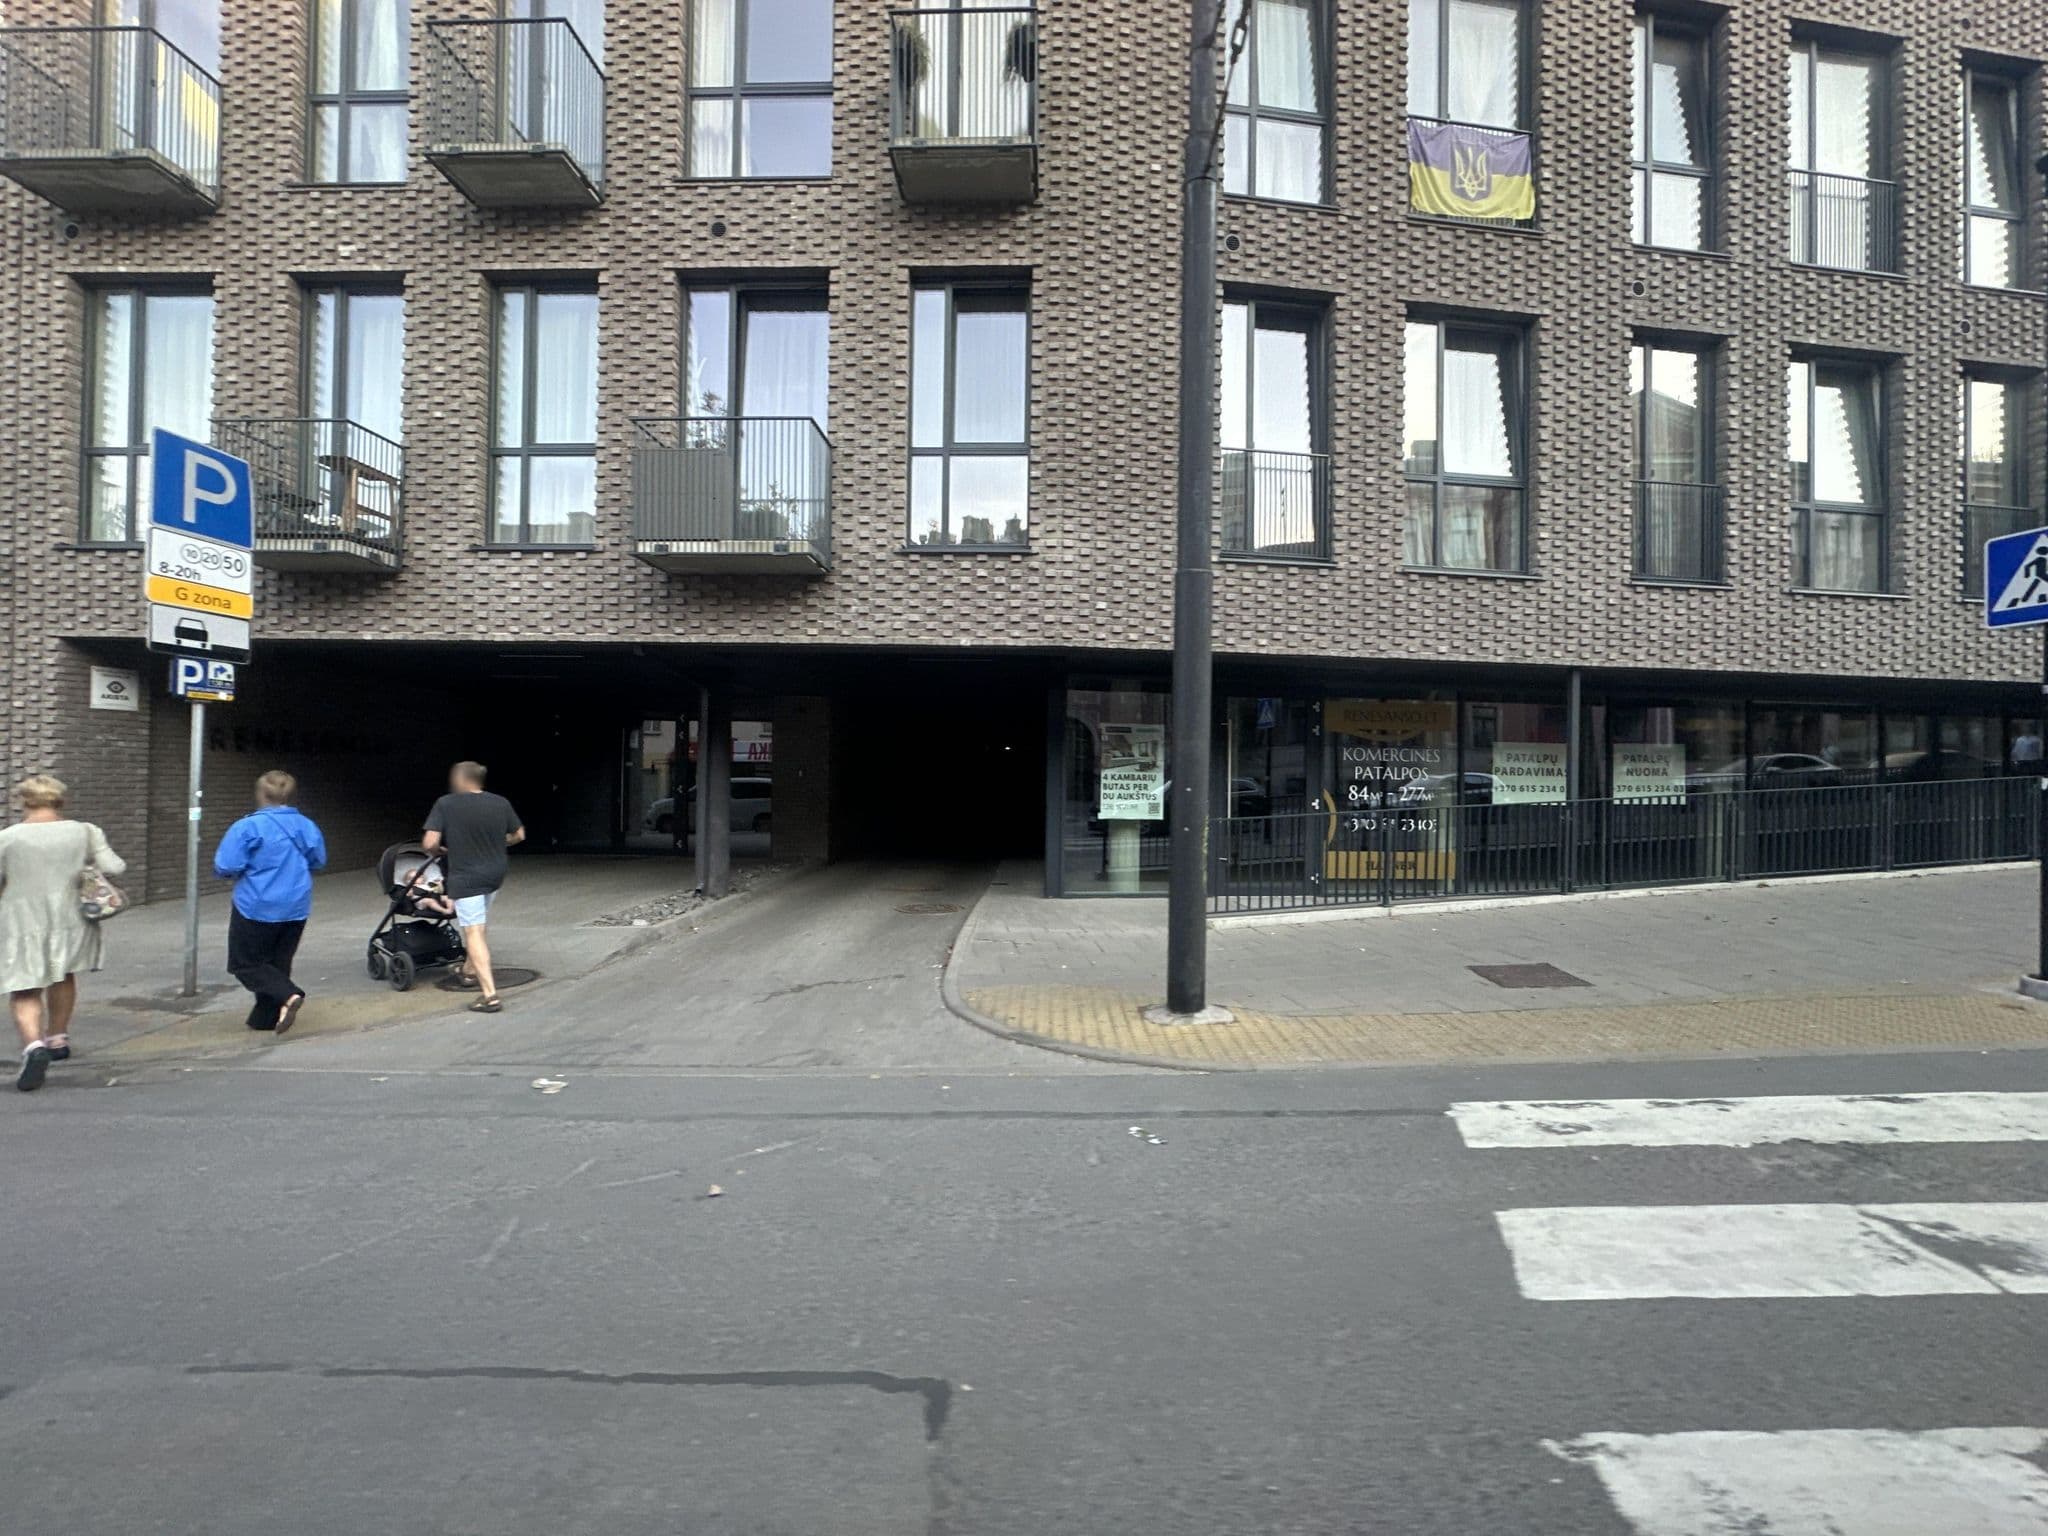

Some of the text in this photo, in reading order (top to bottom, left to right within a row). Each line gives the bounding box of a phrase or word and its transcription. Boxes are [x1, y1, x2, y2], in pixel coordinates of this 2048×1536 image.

[182, 448, 238, 524] P
[185, 548, 243, 572] 10 20 50
[159, 561, 201, 581] 8-20h
[175, 587, 232, 609] G zona
[177, 658, 204, 695] P
[1342, 746, 1441, 762] KOMERCINĖS
[1506, 752, 1558, 766] PATALPŲ
[1102, 773, 1108, 781] 4
[1354, 765, 1430, 780] PATALPOS
[1626, 766, 1668, 777] NUOMA
[1102, 783, 1149, 791] BUTAS PER
[1519, 784, 1537, 793] 615
[1539, 784, 1557, 793] 234
[1654, 784, 1671, 793] 234
[1102, 790, 1157, 801] DU AUKŠTUS
